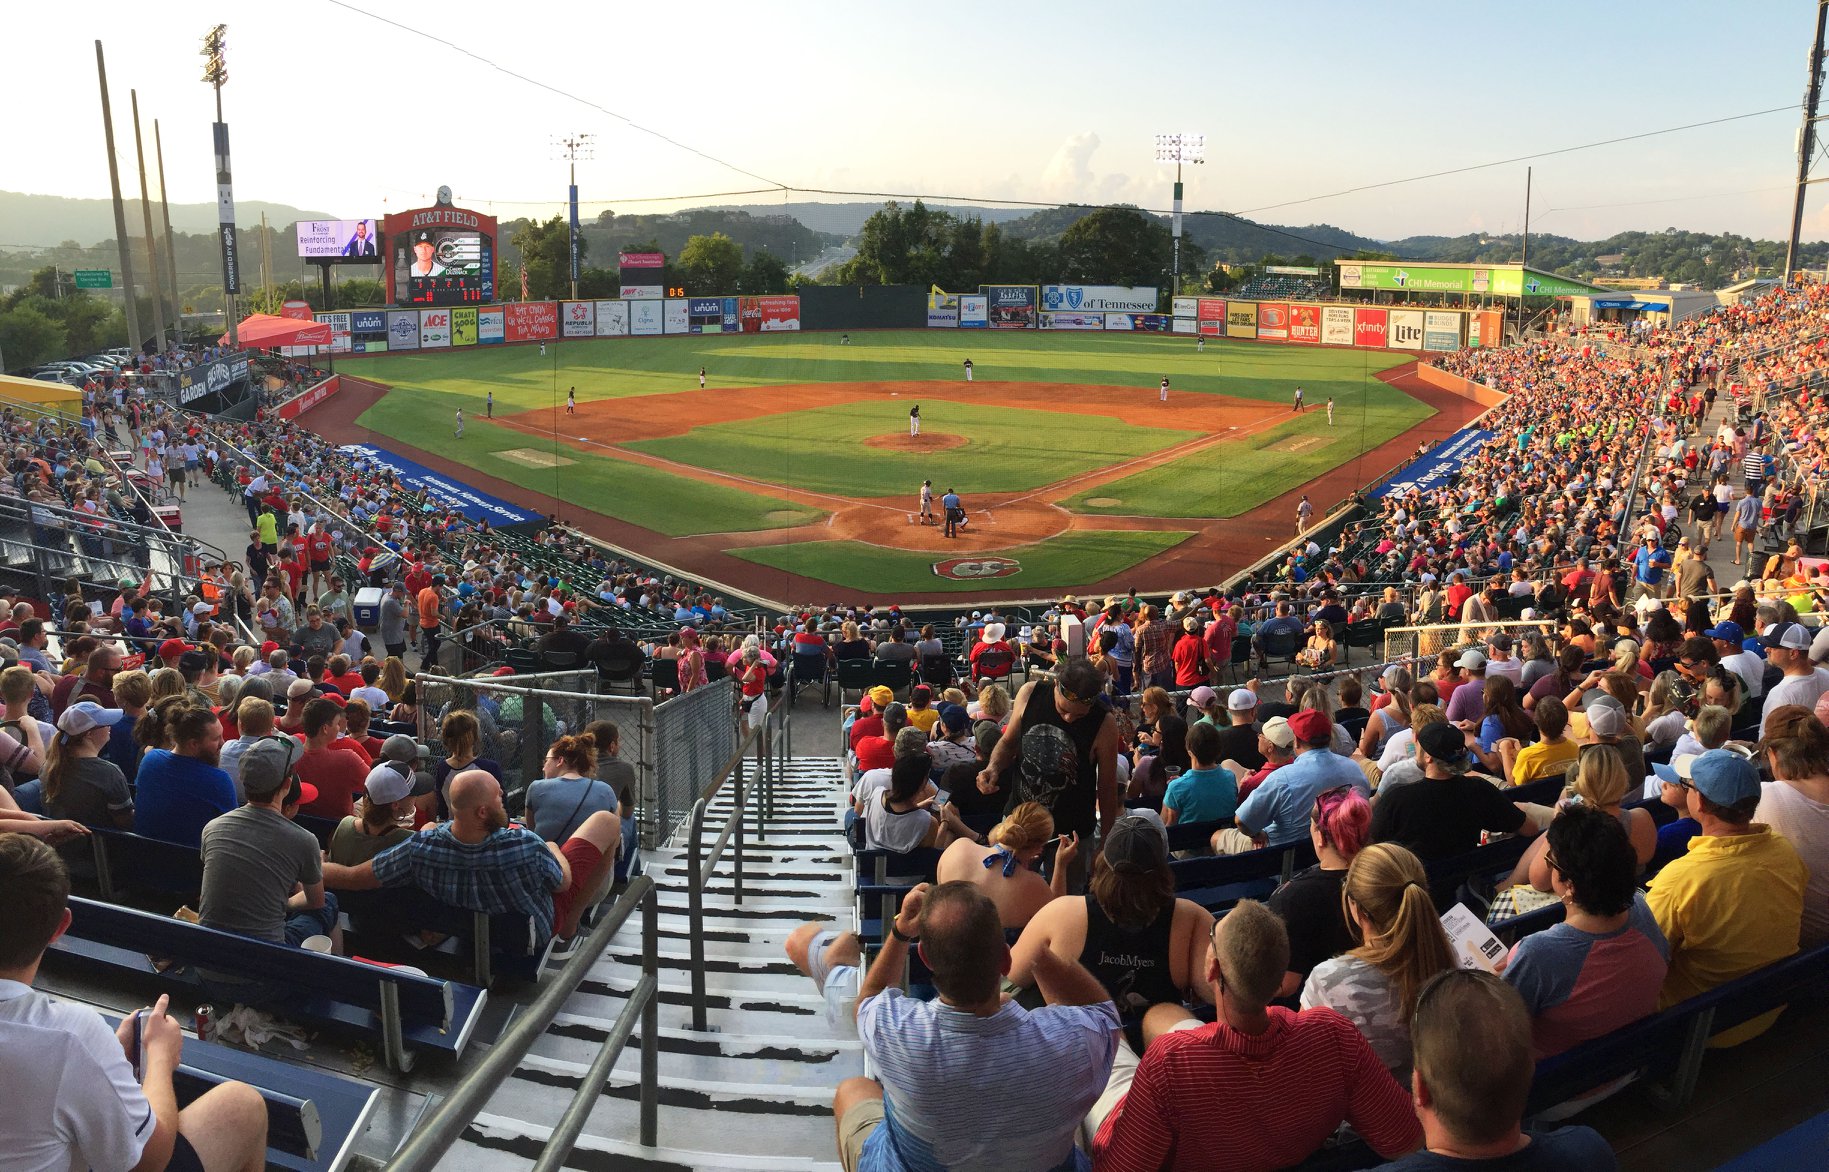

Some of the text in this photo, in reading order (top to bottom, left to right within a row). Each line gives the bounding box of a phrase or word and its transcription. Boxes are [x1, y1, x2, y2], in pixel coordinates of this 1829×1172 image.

[412, 210, 478, 227] AT&T FIELD
[227, 247, 232, 256] BY
[1424, 280, 1462, 288] Memorial
[1083, 299, 1154, 310] of Tennessee
[424, 313, 447, 327] ACE
[1357, 321, 1386, 334] xfinity
[1395, 325, 1421, 343] Lite
[181, 381, 206, 404] GARDEN
[1098, 951, 1155, 968] JacobMyers
